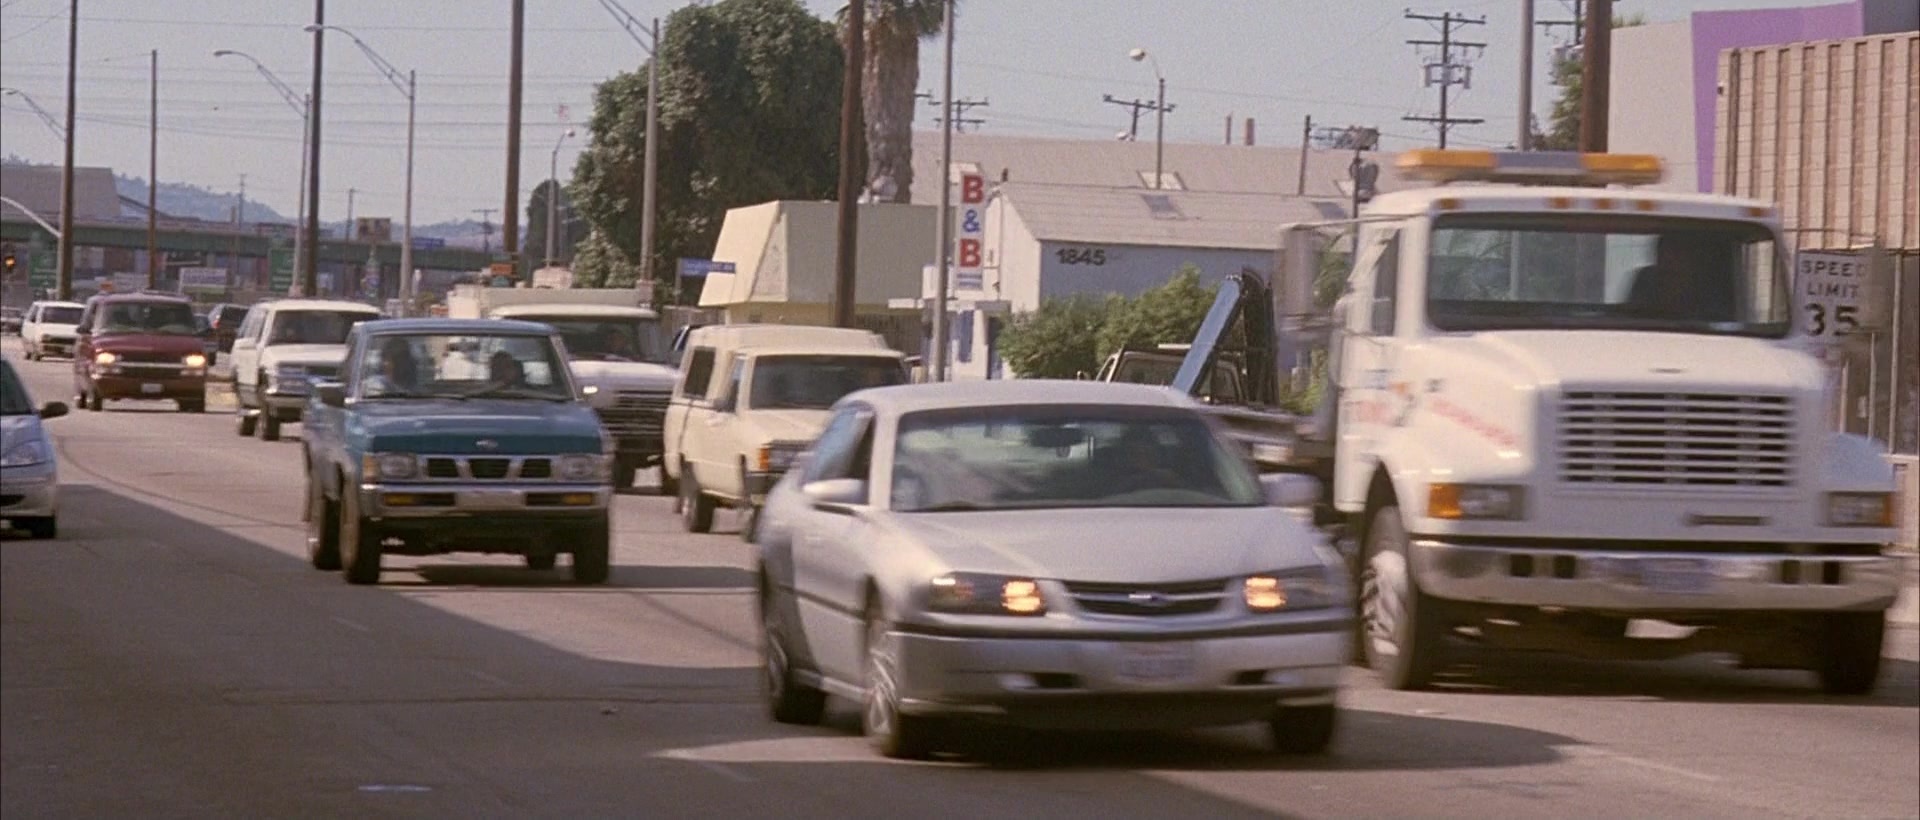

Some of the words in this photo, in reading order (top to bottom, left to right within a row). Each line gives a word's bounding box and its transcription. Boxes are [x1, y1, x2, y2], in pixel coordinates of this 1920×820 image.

[961, 174, 984, 204] B
[962, 209, 980, 233] &
[959, 238, 982, 268] B
[1055, 248, 1107, 266] 1845
[1807, 282, 1859, 298] LIMIT
[1803, 303, 1859, 336] 35
